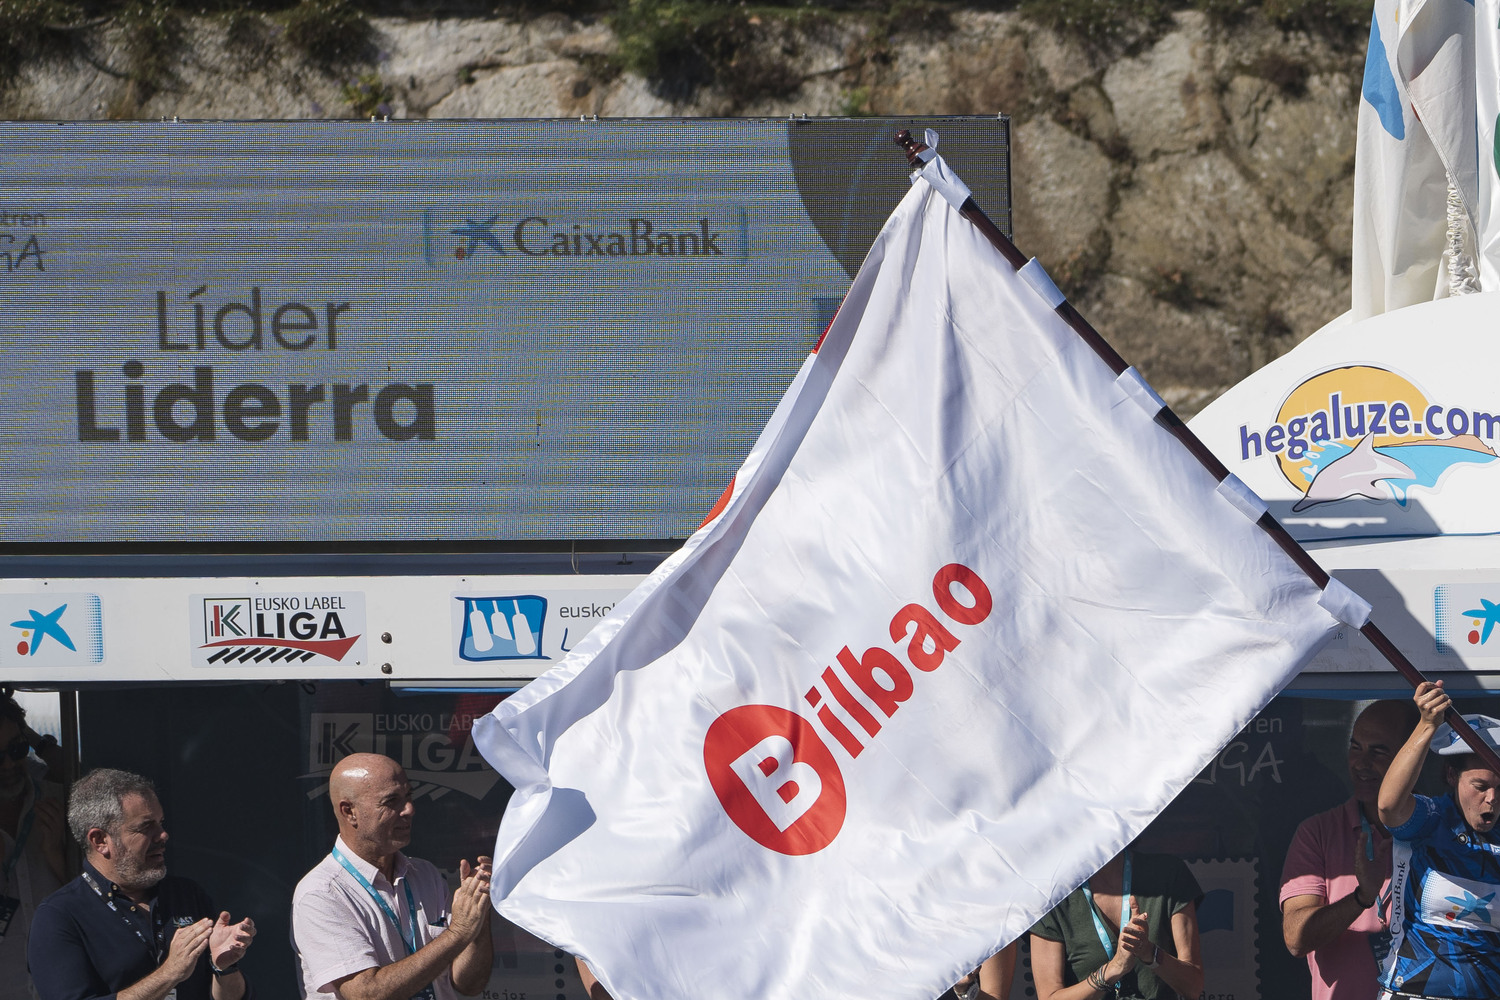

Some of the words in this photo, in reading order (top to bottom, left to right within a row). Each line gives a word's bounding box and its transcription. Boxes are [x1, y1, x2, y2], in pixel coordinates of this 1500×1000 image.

[513, 216, 723, 257] CaixaBank
[157, 284, 350, 351] Líder
[76, 359, 436, 442] Liderra
[255, 597, 300, 610] EUSKO
[305, 597, 346, 610] LABEL
[257, 612, 347, 639] LIGA
[376, 715, 433, 731] EUSKO
[722, 563, 993, 836] Bilbao
[1391, 860, 1407, 936] CaixaBank
